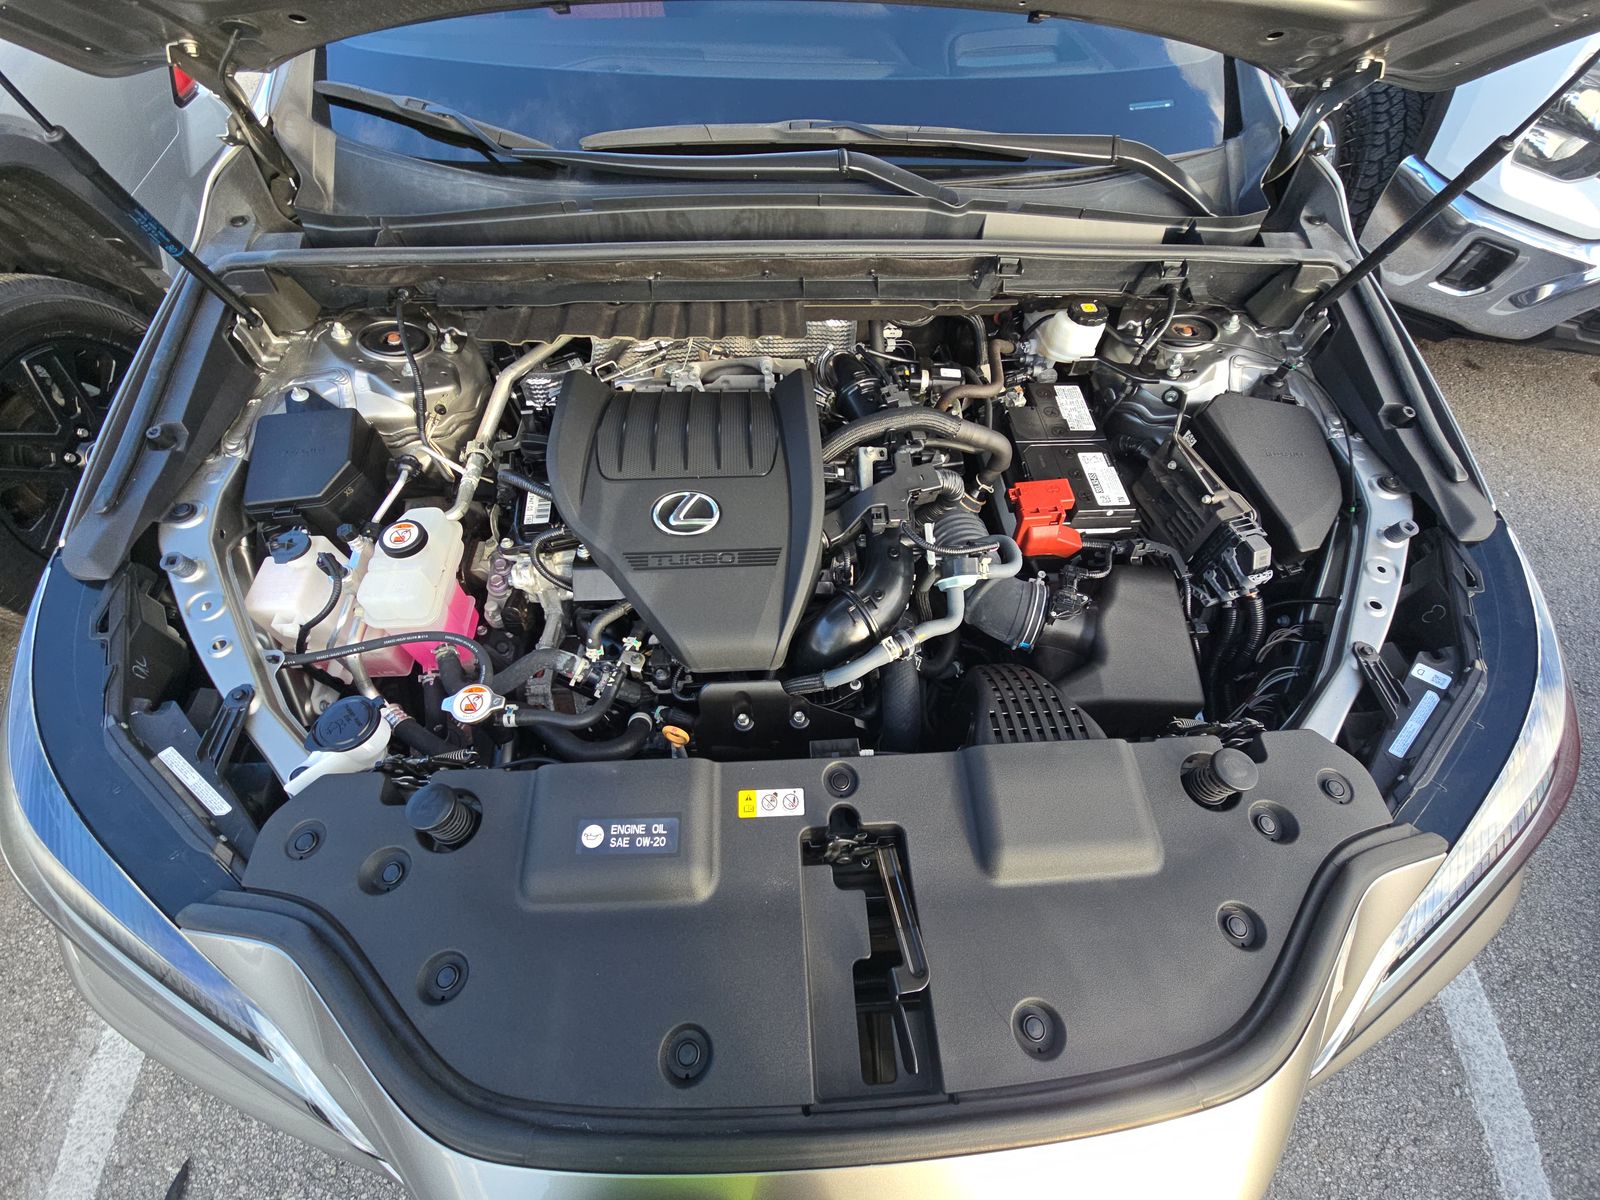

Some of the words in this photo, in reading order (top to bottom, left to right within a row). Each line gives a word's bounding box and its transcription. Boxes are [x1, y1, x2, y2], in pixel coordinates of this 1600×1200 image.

[650, 552, 736, 566] TURBO
[610, 824, 646, 835] ENGINE
[652, 824, 667, 834] OIL
[609, 837, 630, 848] SAE
[635, 837, 666, 847] 0W-20
